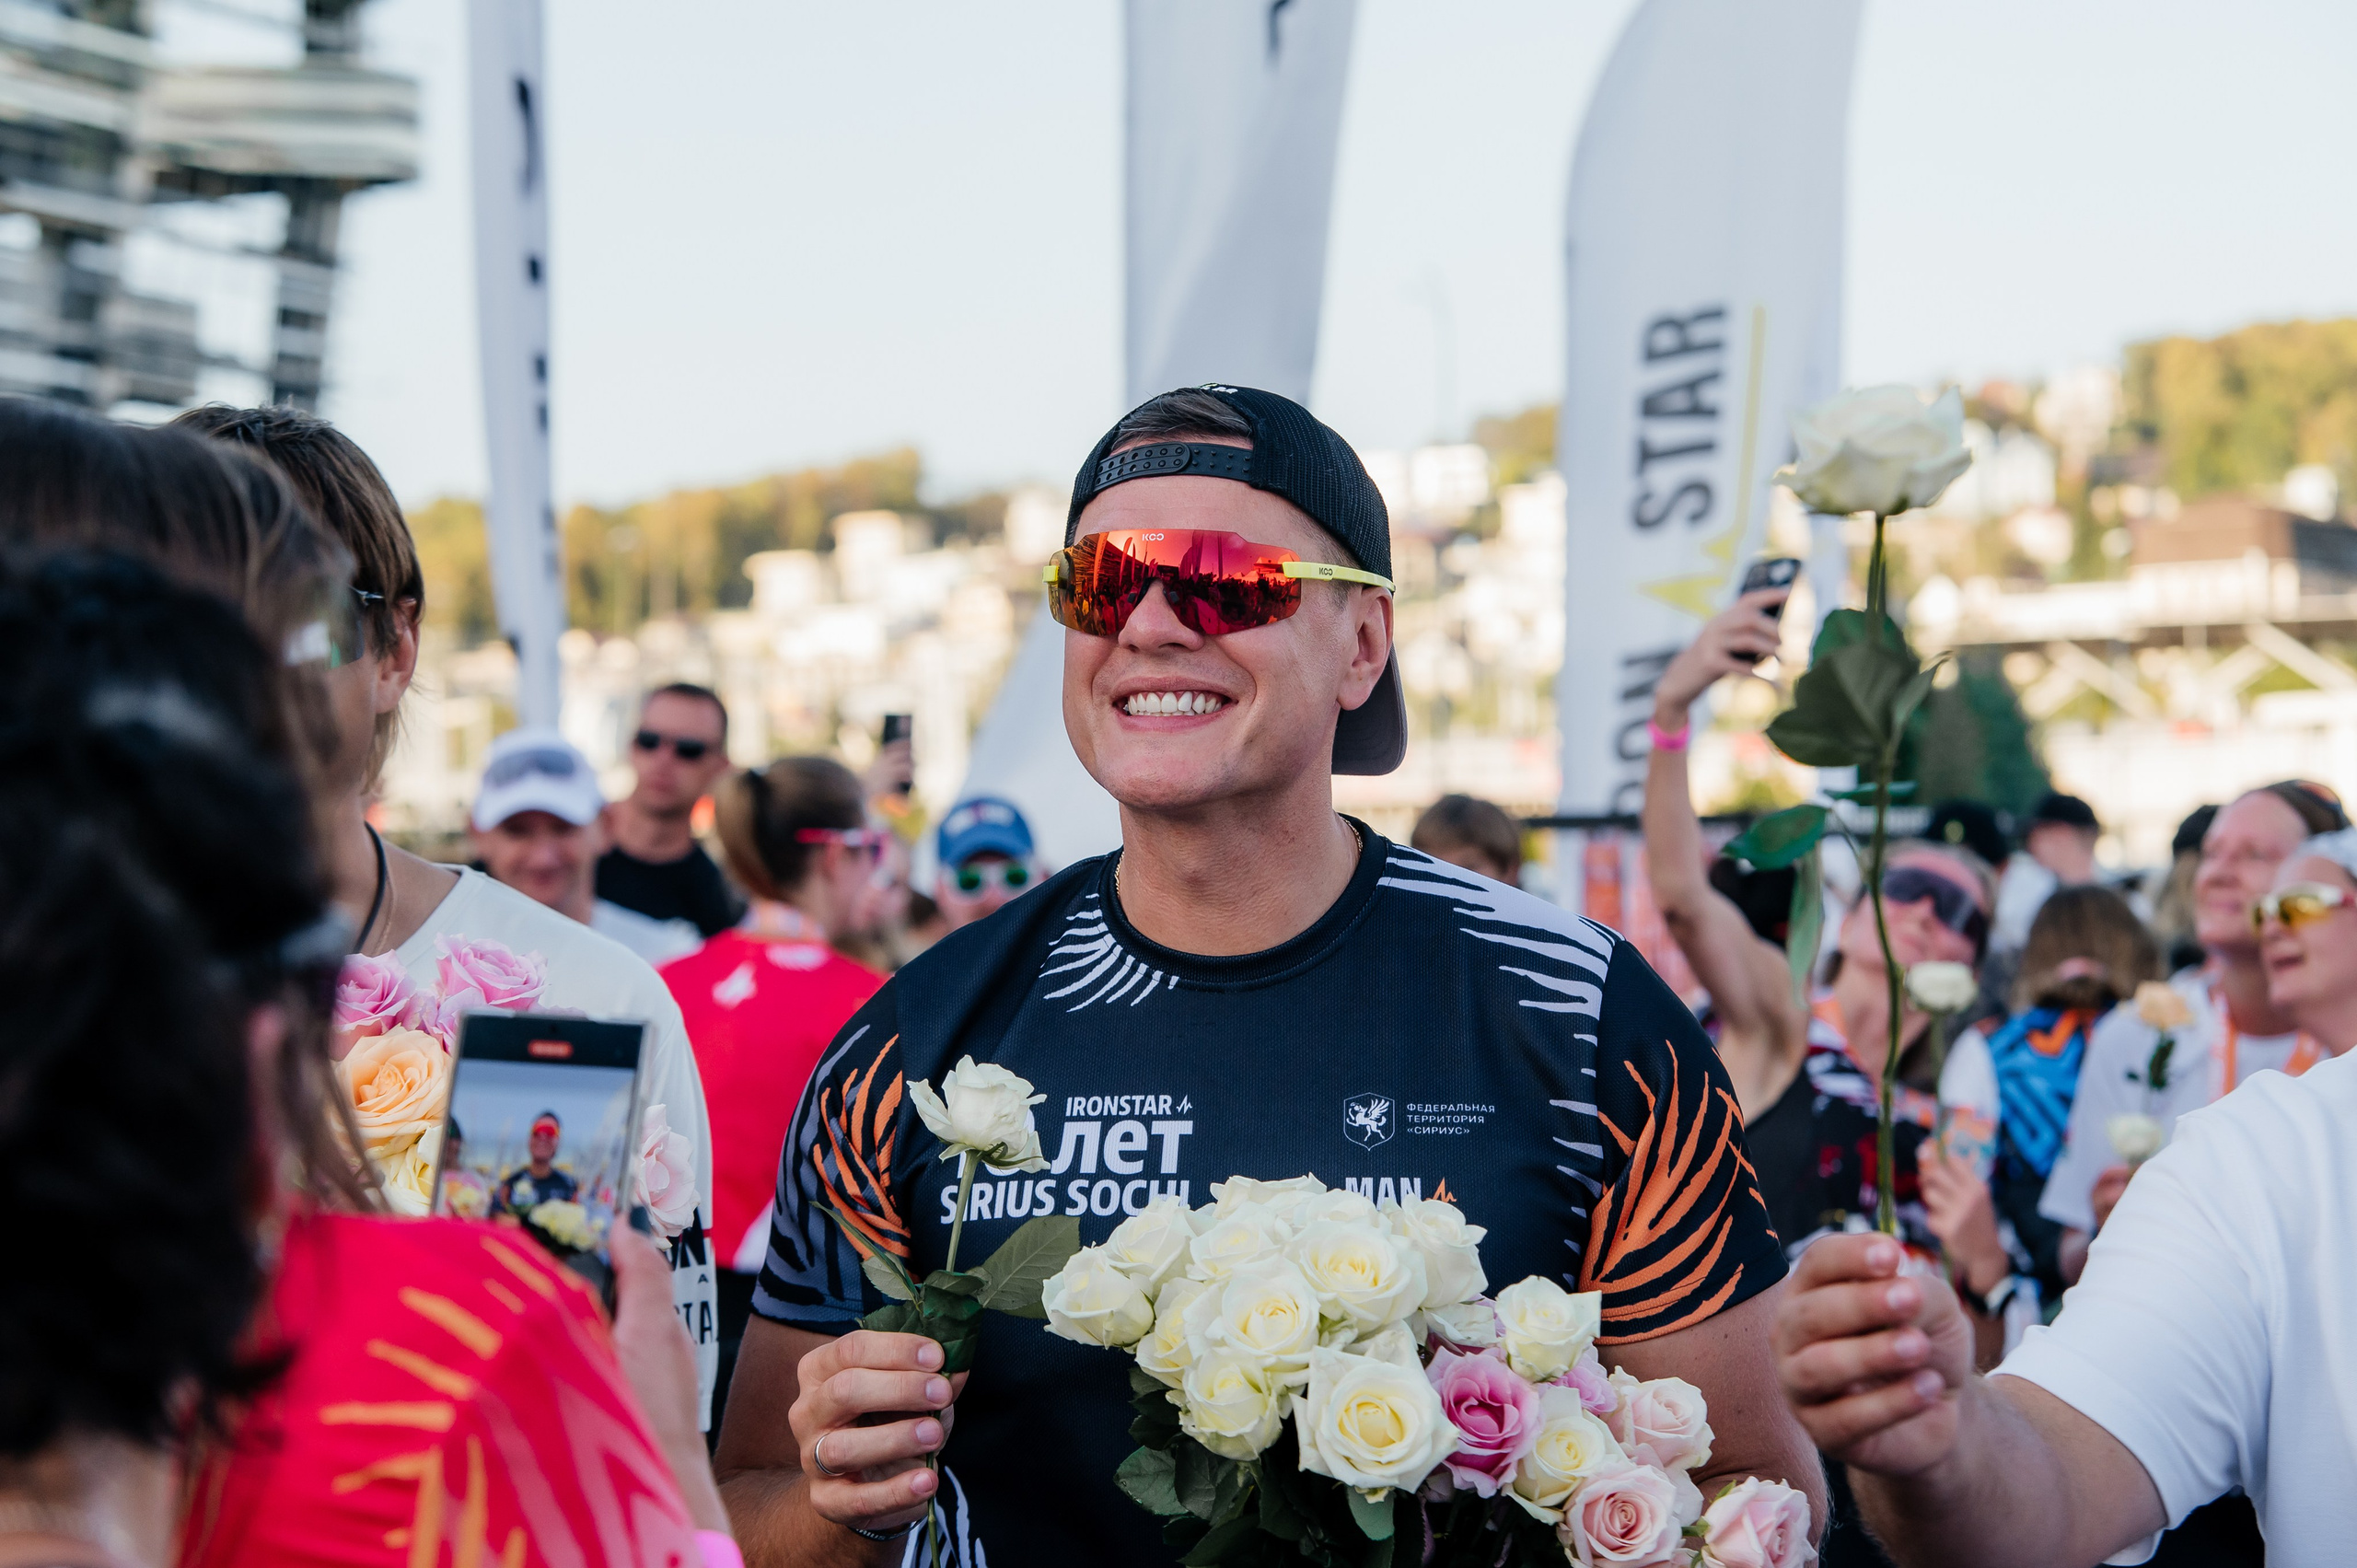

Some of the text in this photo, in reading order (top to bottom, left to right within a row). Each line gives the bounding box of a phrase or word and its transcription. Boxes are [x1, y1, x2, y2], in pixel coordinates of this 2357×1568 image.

[1631, 304, 1727, 531] STAR
[1065, 1095, 1172, 1117] IRONSTAR
[1406, 1103, 1496, 1113] ФЕДЕРАЛЬНАЯ
[1406, 1115, 1485, 1124] ТЕРРИТОРИЯ
[1406, 1126, 1470, 1135] «СИРИУС»
[1050, 1120, 1194, 1175] лет
